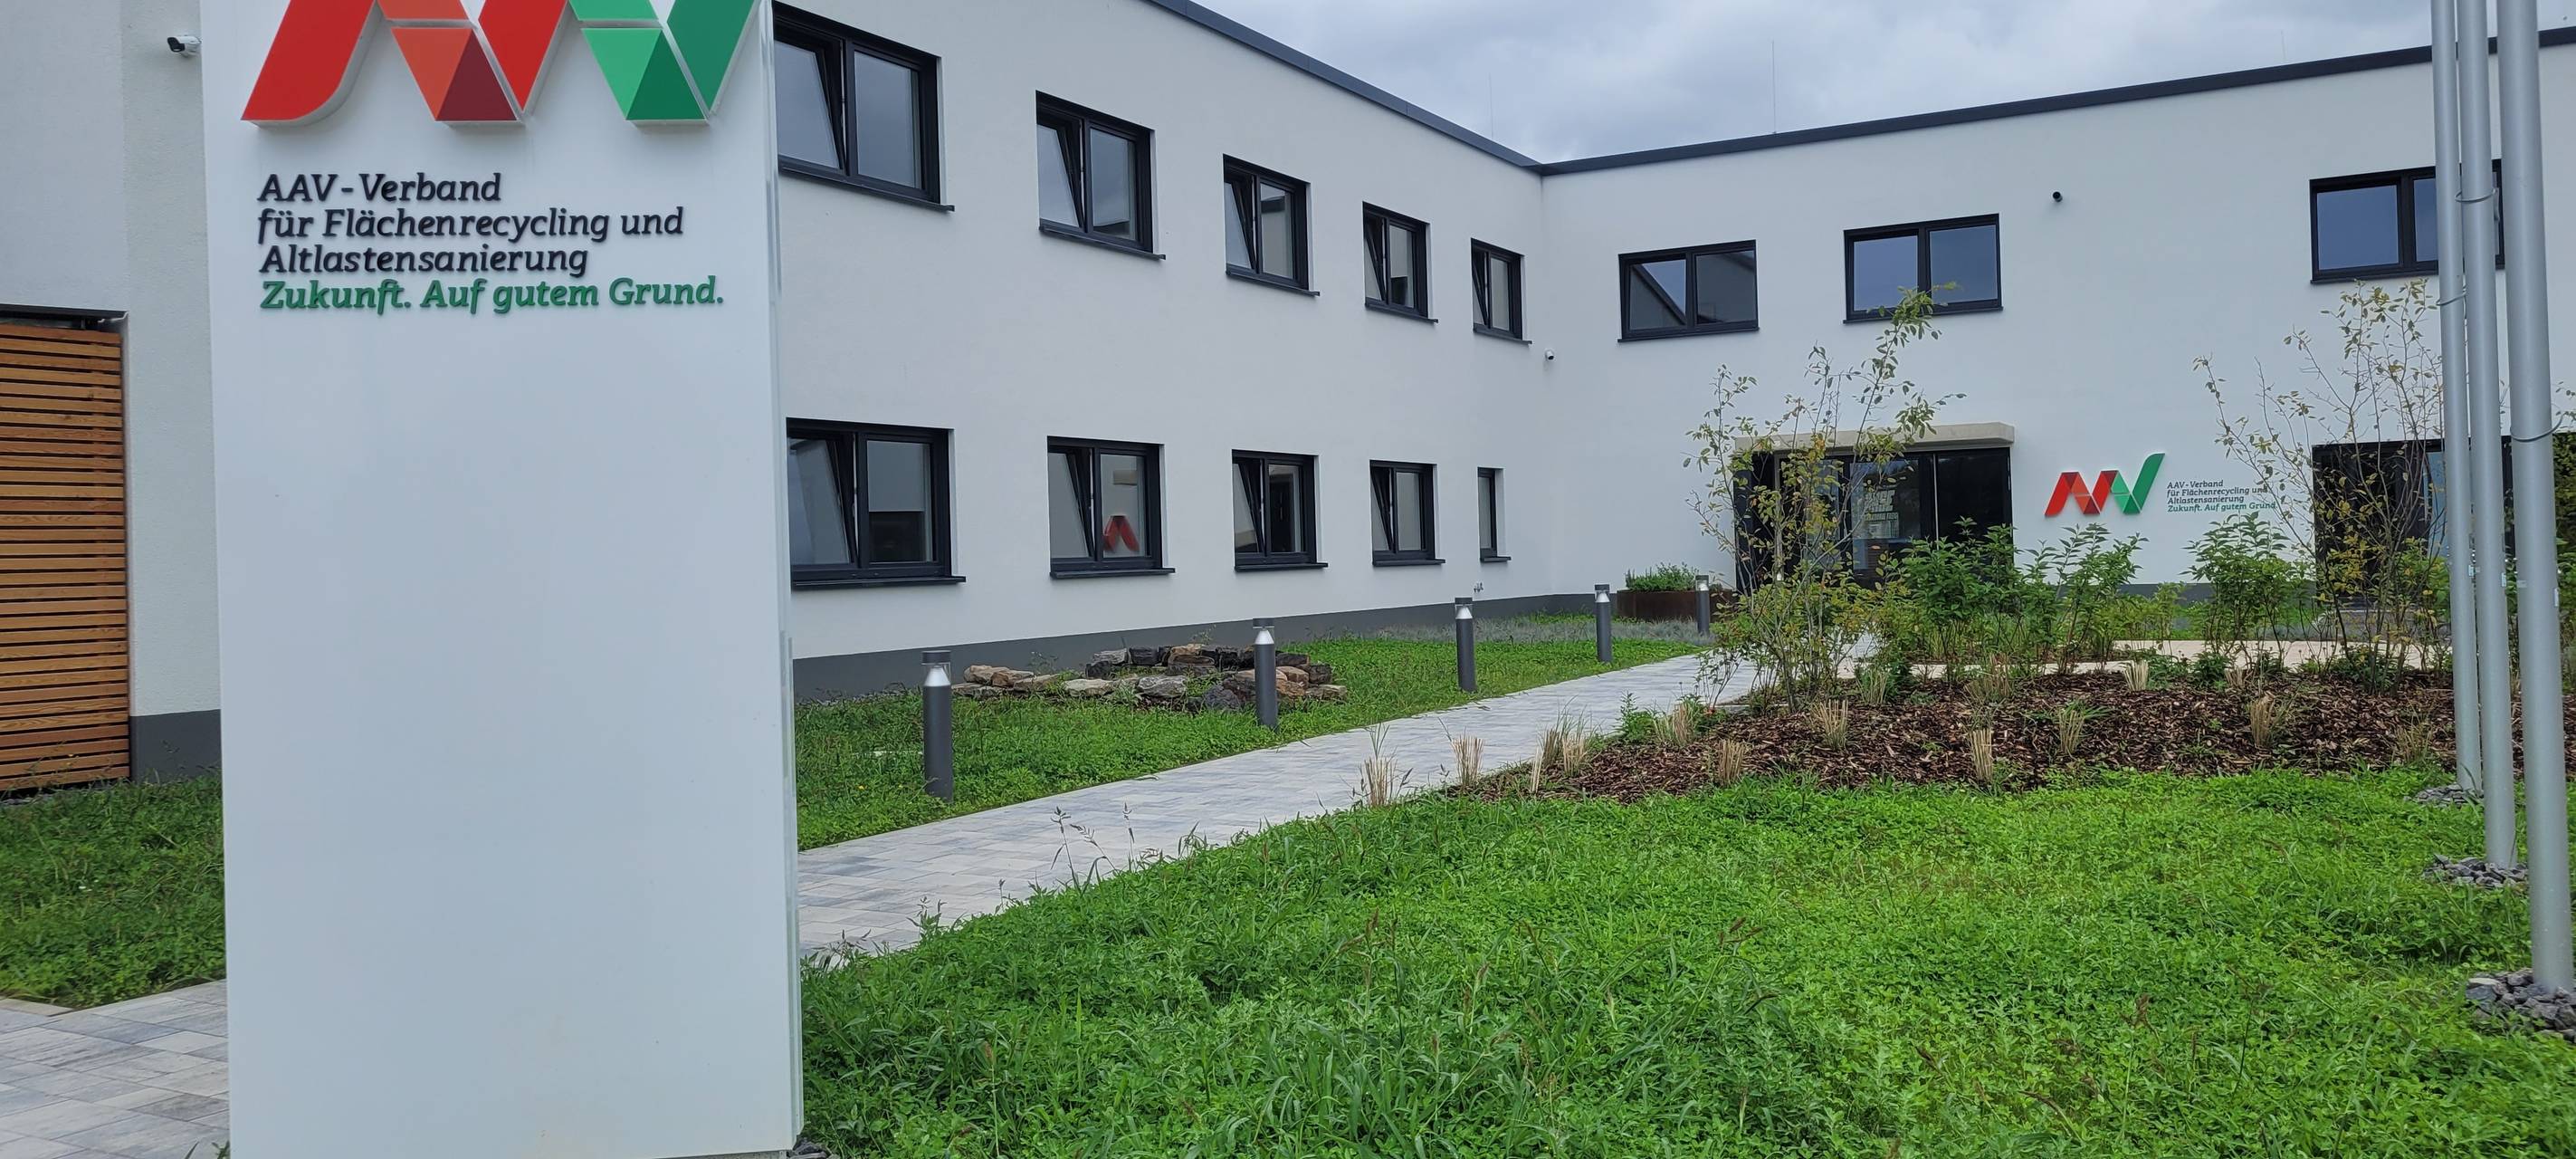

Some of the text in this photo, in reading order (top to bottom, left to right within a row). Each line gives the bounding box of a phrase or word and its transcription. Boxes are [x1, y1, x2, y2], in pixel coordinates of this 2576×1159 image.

[257, 173, 339, 203] AAV
[258, 206, 683, 244] für Flächenrecycling und
[259, 244, 589, 279] Altlastensanierung
[260, 274, 724, 316] Zukunft. Auf gutem Grund.
[2167, 489, 2180, 498] für
[2181, 486, 2250, 496] Flächenrecycling
[2167, 495, 2245, 504] Altlastensanierung
[2168, 503, 2203, 513] Zukunft.
[2204, 503, 2220, 512] Auf
[2220, 503, 2247, 512] gutem
